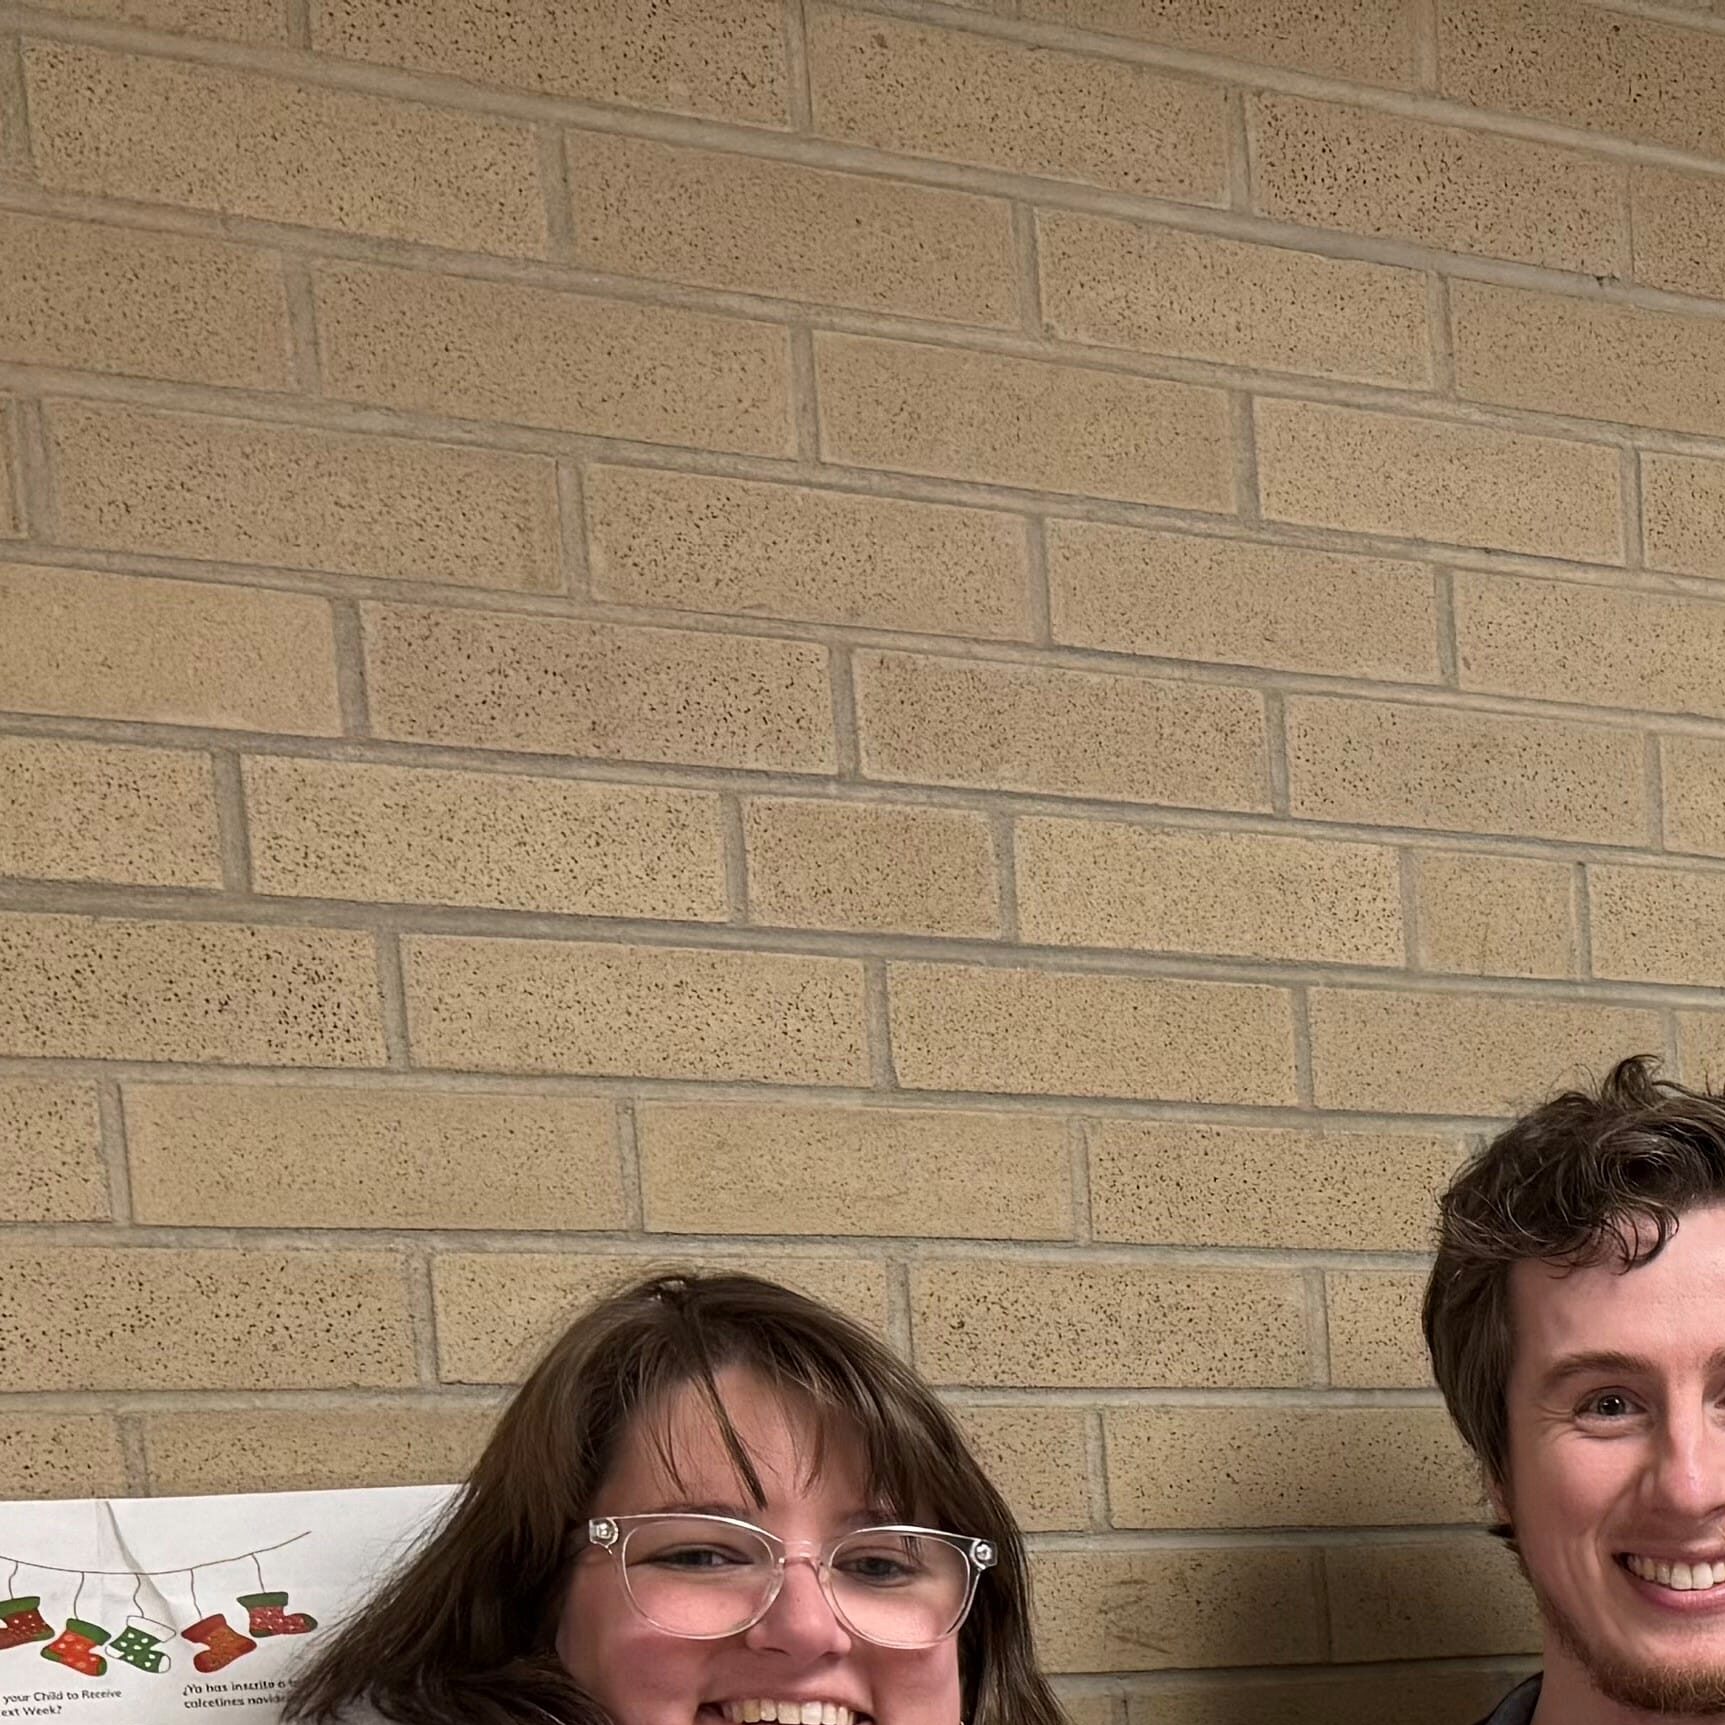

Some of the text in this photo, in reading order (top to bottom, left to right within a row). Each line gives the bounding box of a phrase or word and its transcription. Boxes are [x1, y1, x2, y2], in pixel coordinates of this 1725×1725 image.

[3, 1688, 122, 1706] your Child to Receive
[22, 1704, 62, 1716] Week?
